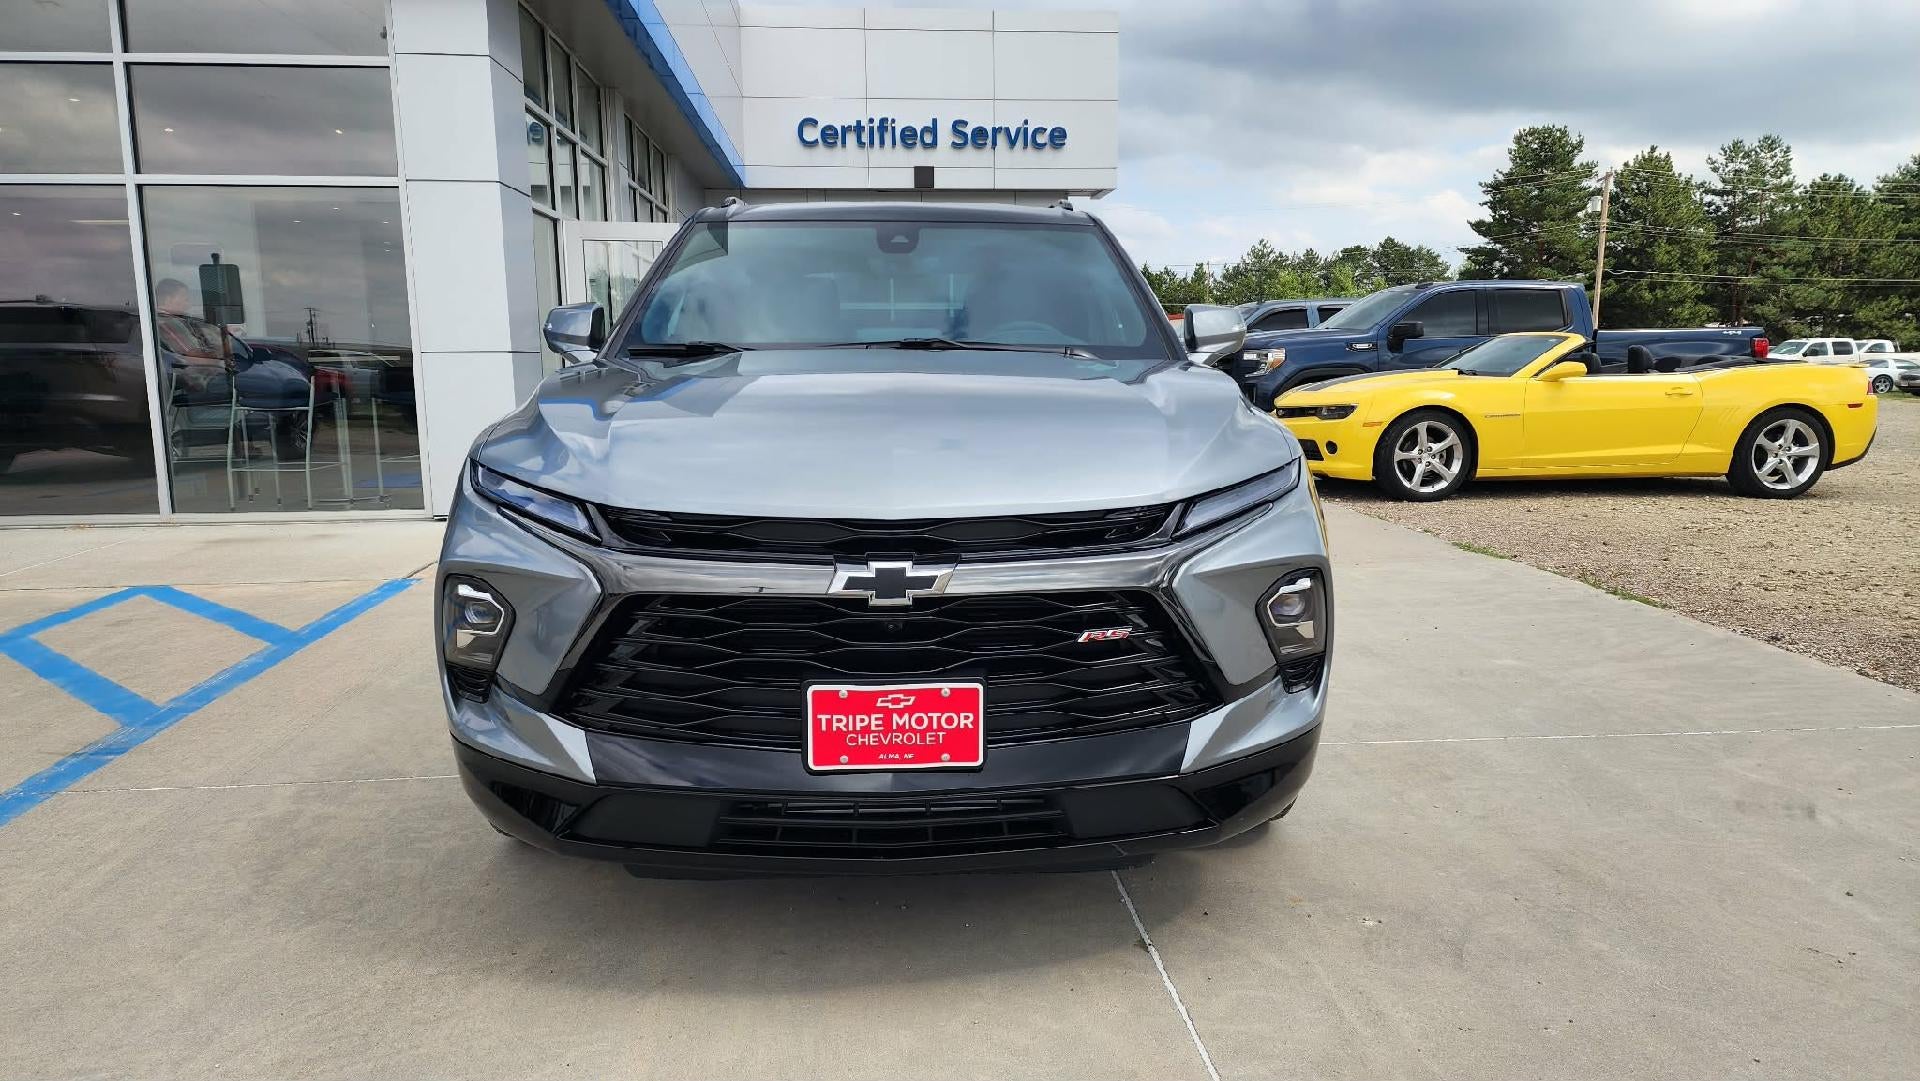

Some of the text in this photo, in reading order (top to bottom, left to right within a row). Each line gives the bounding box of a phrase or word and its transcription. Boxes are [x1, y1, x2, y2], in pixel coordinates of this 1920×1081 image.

[797, 117, 1068, 149] Certified Service
[1077, 628, 1132, 642] RS
[817, 712, 974, 731] TRIPE MOTOR
[846, 731, 946, 746] CHEVROLET
